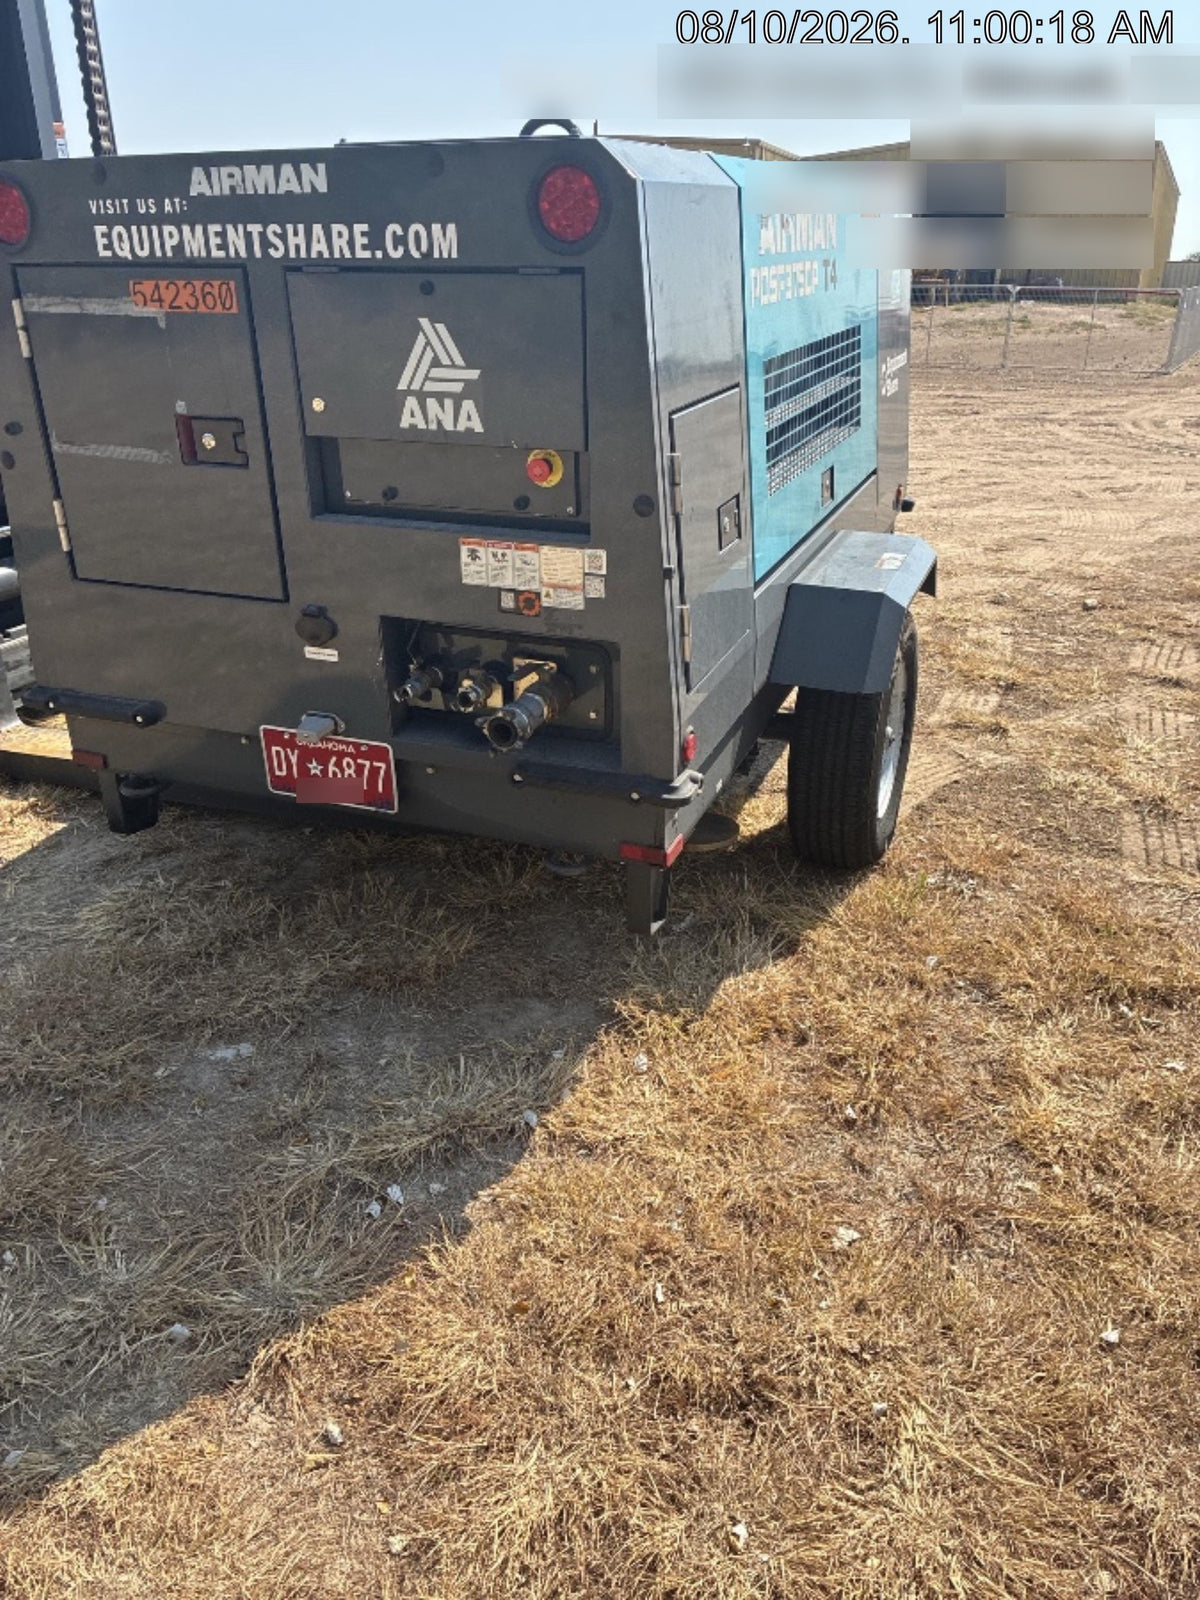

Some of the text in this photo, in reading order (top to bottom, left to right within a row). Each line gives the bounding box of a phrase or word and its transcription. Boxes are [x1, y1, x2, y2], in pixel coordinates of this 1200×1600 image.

[189, 163, 328, 196] AIRMAN
[89, 198, 189, 214] VISIT US AT:
[93, 223, 459, 260] EQUIPMENTSHARE.COM
[132, 281, 234, 312] 542360
[399, 396, 485, 433] ANA
[271, 746, 387, 794] DY 6877
